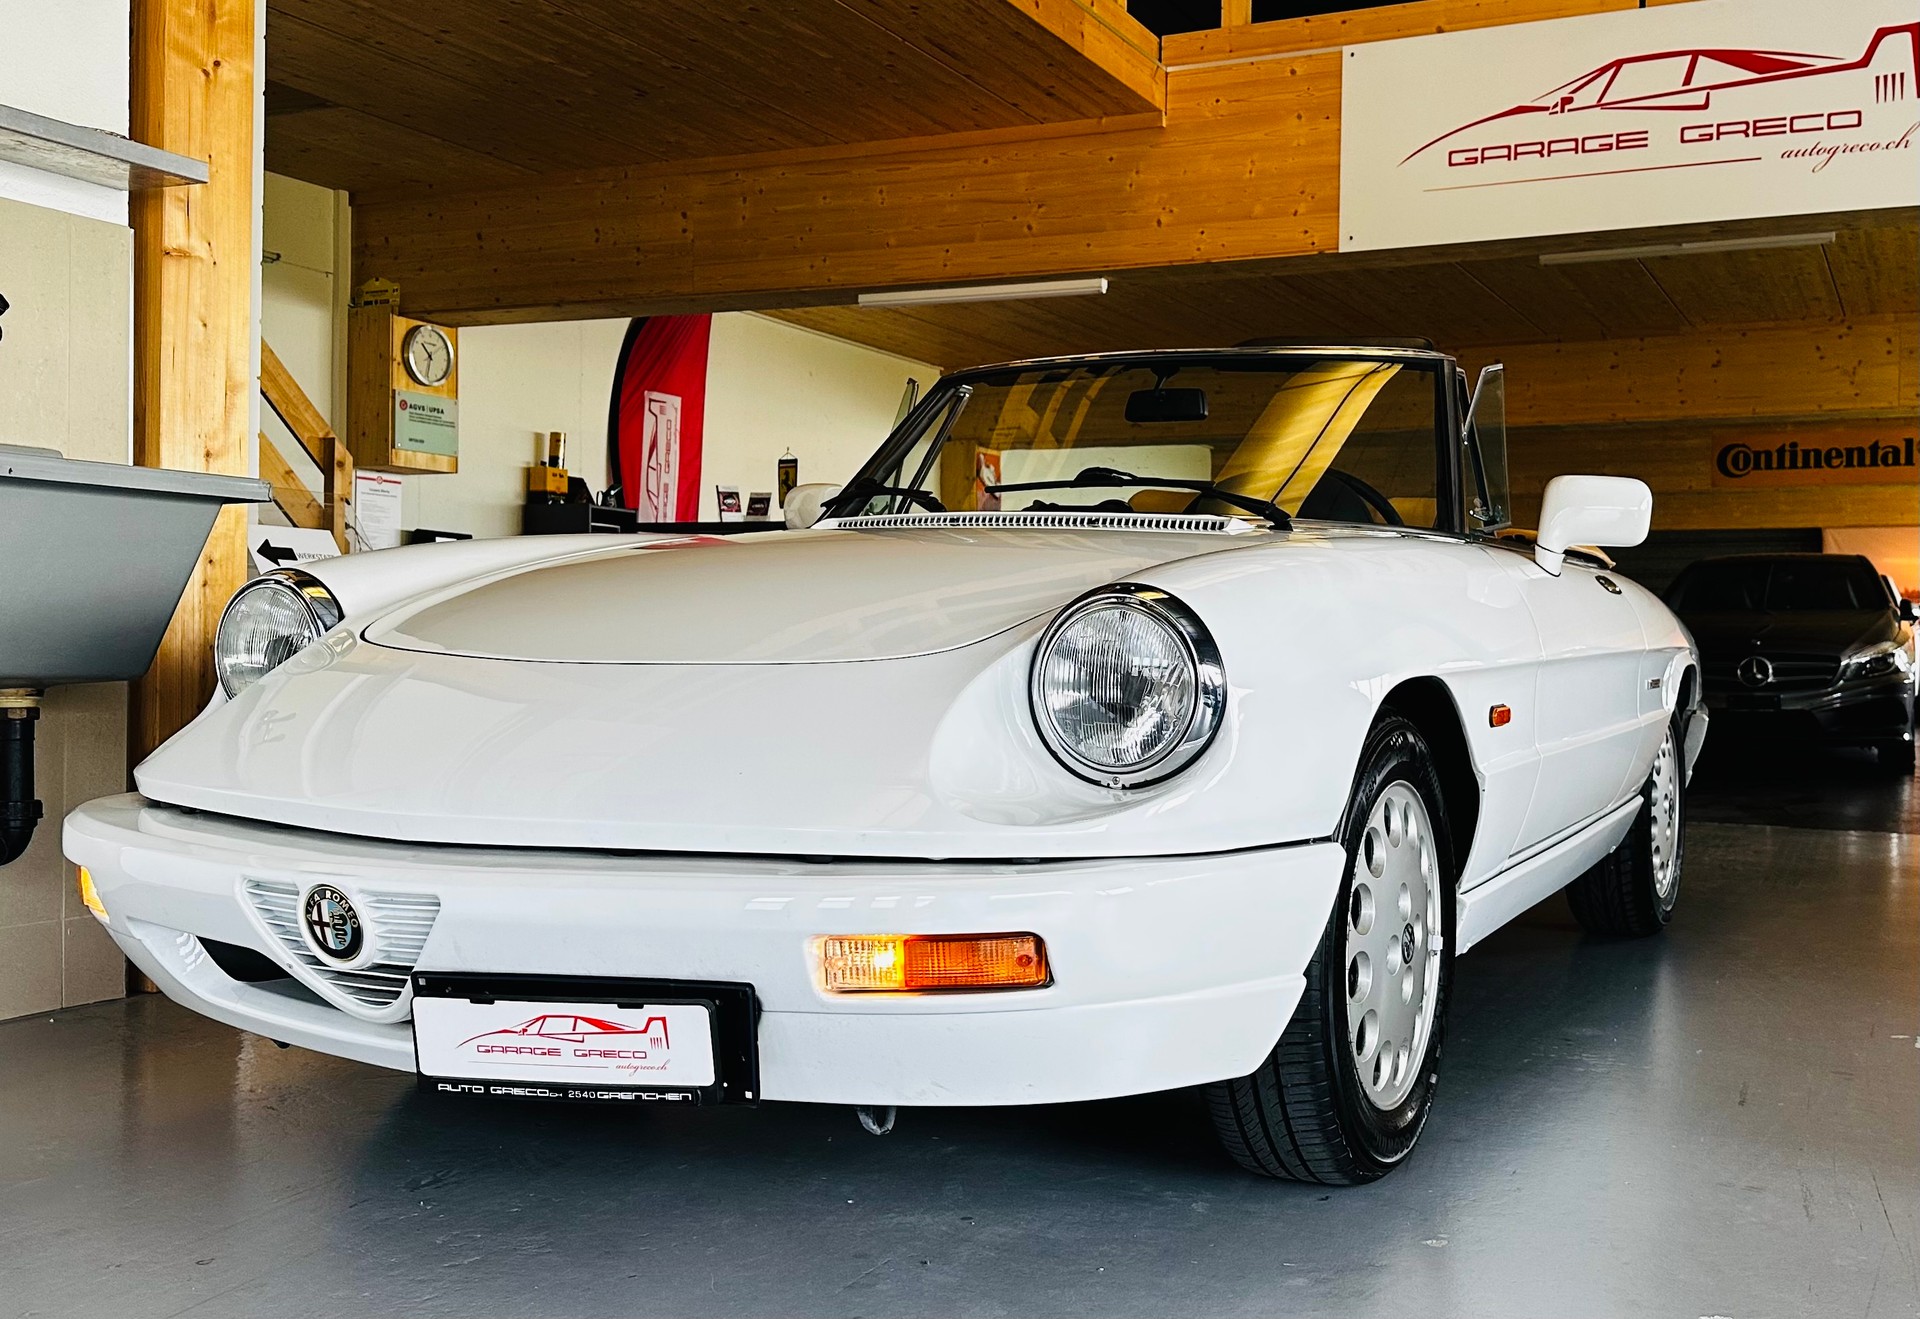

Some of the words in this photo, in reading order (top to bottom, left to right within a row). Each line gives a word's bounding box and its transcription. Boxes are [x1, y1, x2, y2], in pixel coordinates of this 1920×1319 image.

[1447, 130, 1649, 168] GARAGE
[1680, 109, 1863, 144] GRECO
[1780, 120, 1920, 173] autogreco.ch
[408, 403, 426, 412] AGVS
[428, 406, 445, 415] UPSA
[1716, 437, 1916, 479] Continental
[306, 893, 321, 922] ALFA
[325, 890, 359, 928] ROMEO
[476, 1044, 562, 1057] GARAGE
[573, 1048, 648, 1060] GRECO
[615, 1059, 672, 1077] autogreco.ch
[437, 1083, 485, 1094] AUTO
[568, 1089, 596, 1099] 2540
[596, 1091, 692, 1101] GRENCHEN
